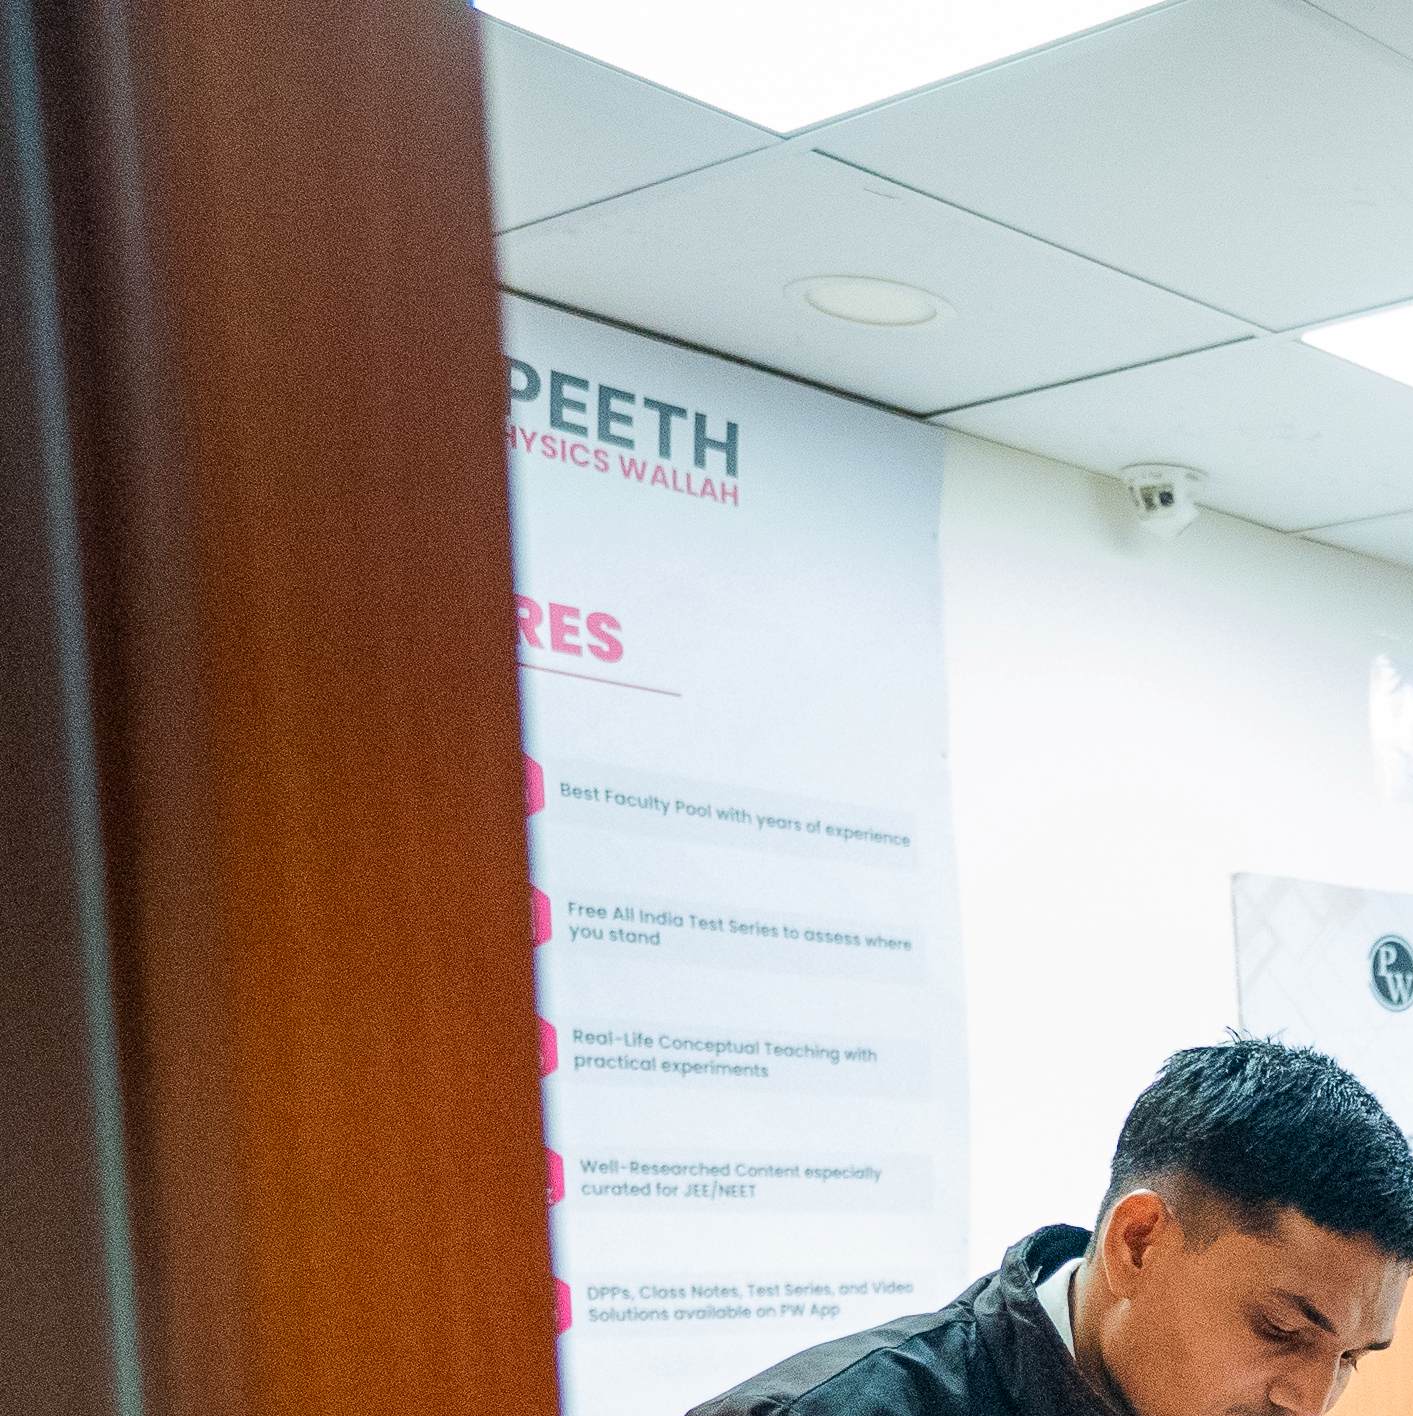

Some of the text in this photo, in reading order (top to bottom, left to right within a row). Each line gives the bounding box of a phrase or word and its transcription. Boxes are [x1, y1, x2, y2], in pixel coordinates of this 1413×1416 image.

[619, 455, 739, 507] WALLAH
[560, 782, 911, 847] Best Faculty Pool with years of experience
[568, 901, 912, 951] Free All India Test Series to assess where
[569, 924, 660, 946] you stand
[573, 1030, 877, 1064] Real-Life Conceptual Teaching with
[574, 1053, 769, 1079] practical experiments
[580, 1158, 882, 1183] Well-Researched Content especially
[581, 1181, 756, 1202] curated for JEE/NEET
[587, 1278, 914, 1301] DPPs, Class Notes, Test Series, and Video
[588, 1301, 841, 1323] Solutions available on PW App
